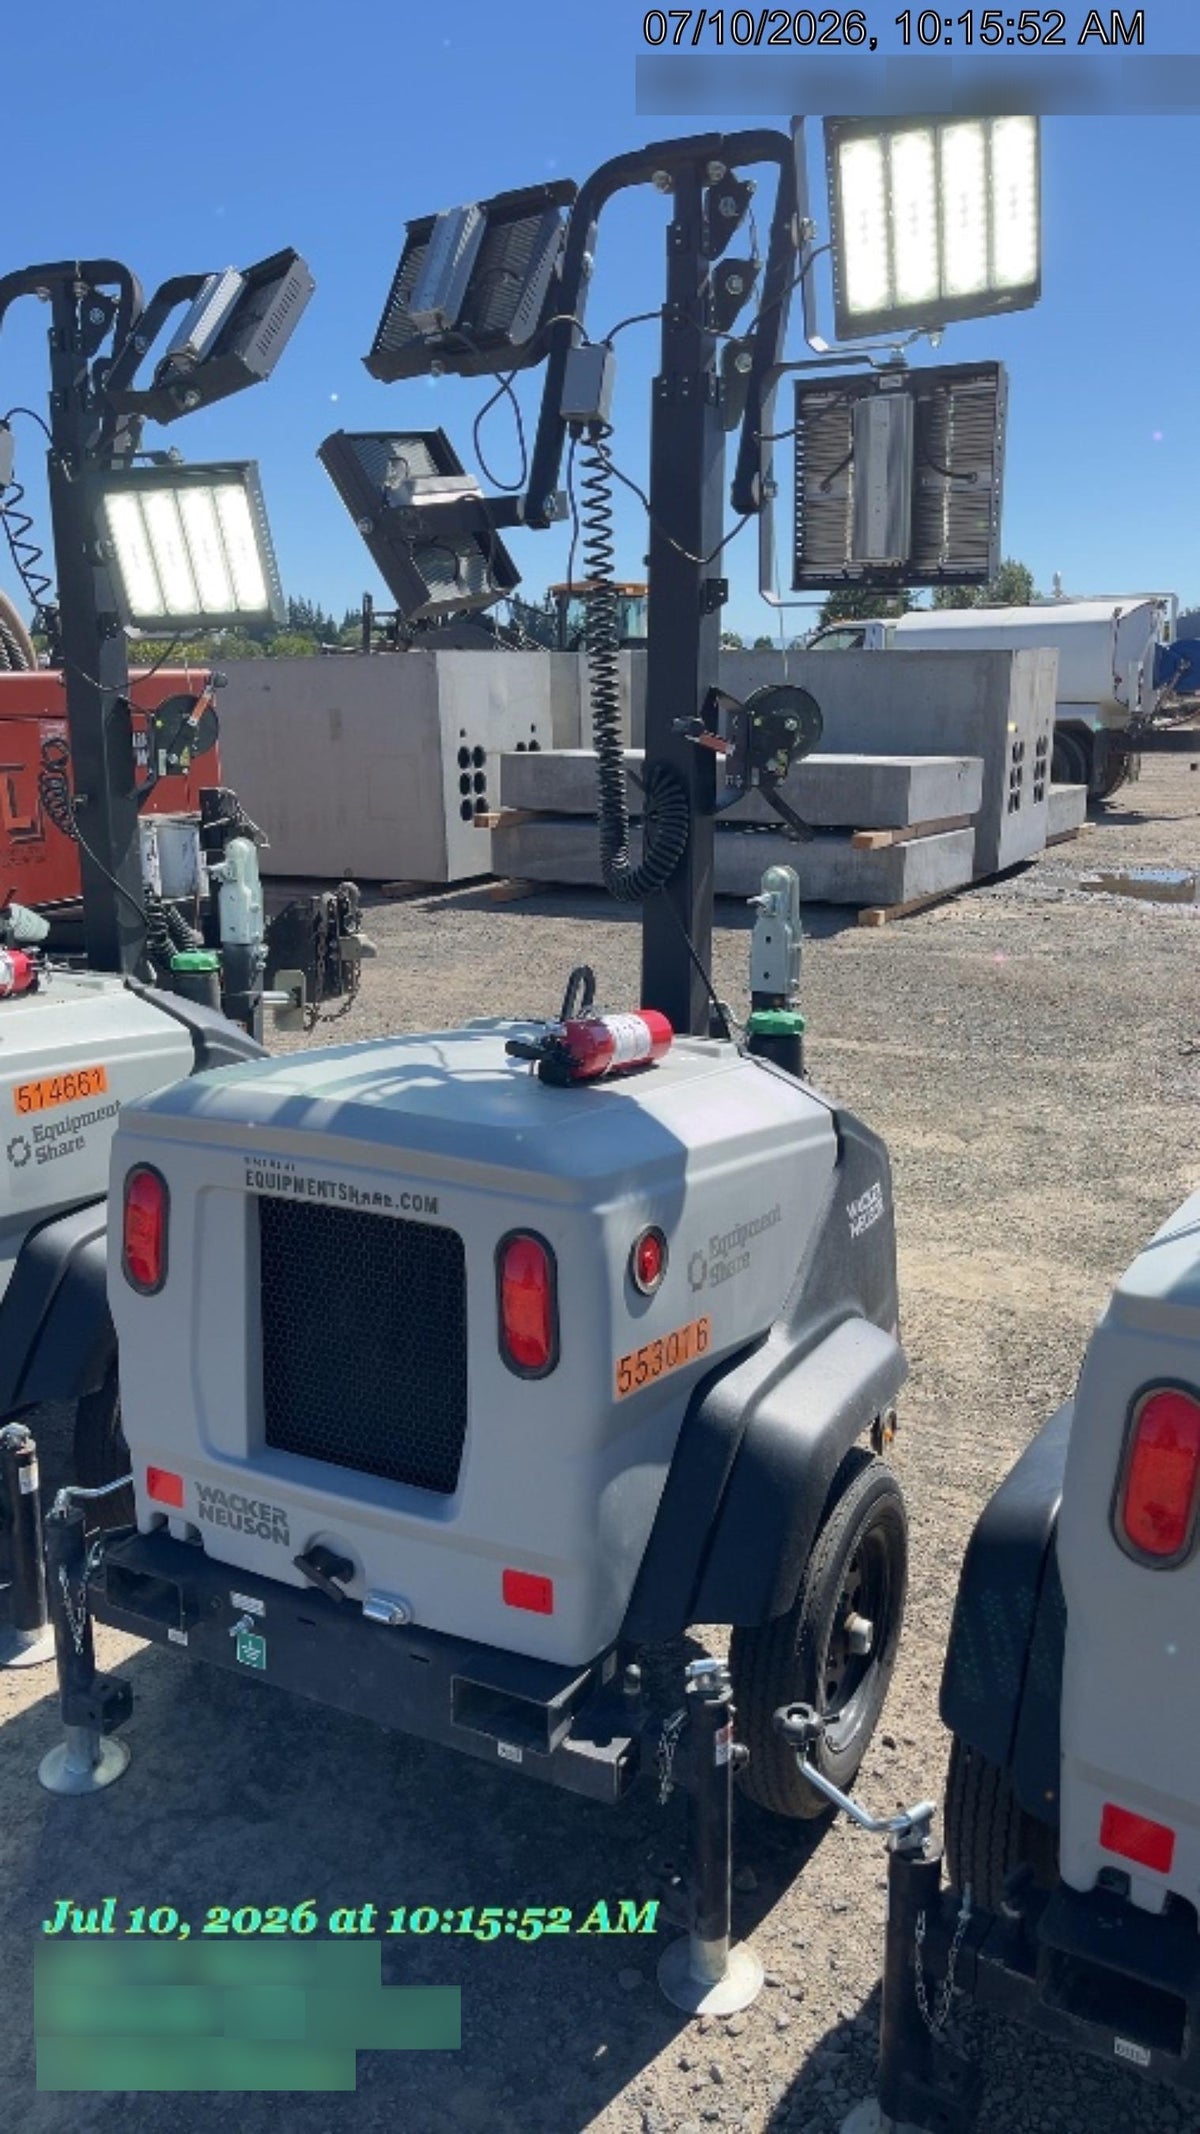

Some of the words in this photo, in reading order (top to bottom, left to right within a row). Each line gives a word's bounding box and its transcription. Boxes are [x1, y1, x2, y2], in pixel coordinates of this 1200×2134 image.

[17, 1069, 102, 1113] 514661
[31, 1100, 121, 1144] Equipment
[34, 1135, 86, 1165] Share
[708, 1203, 782, 1260] Equipment
[709, 1251, 751, 1288] Share
[617, 1317, 708, 1394] 553016
[194, 1481, 288, 1528] WACKER
[199, 1502, 290, 1547] NEUSON
